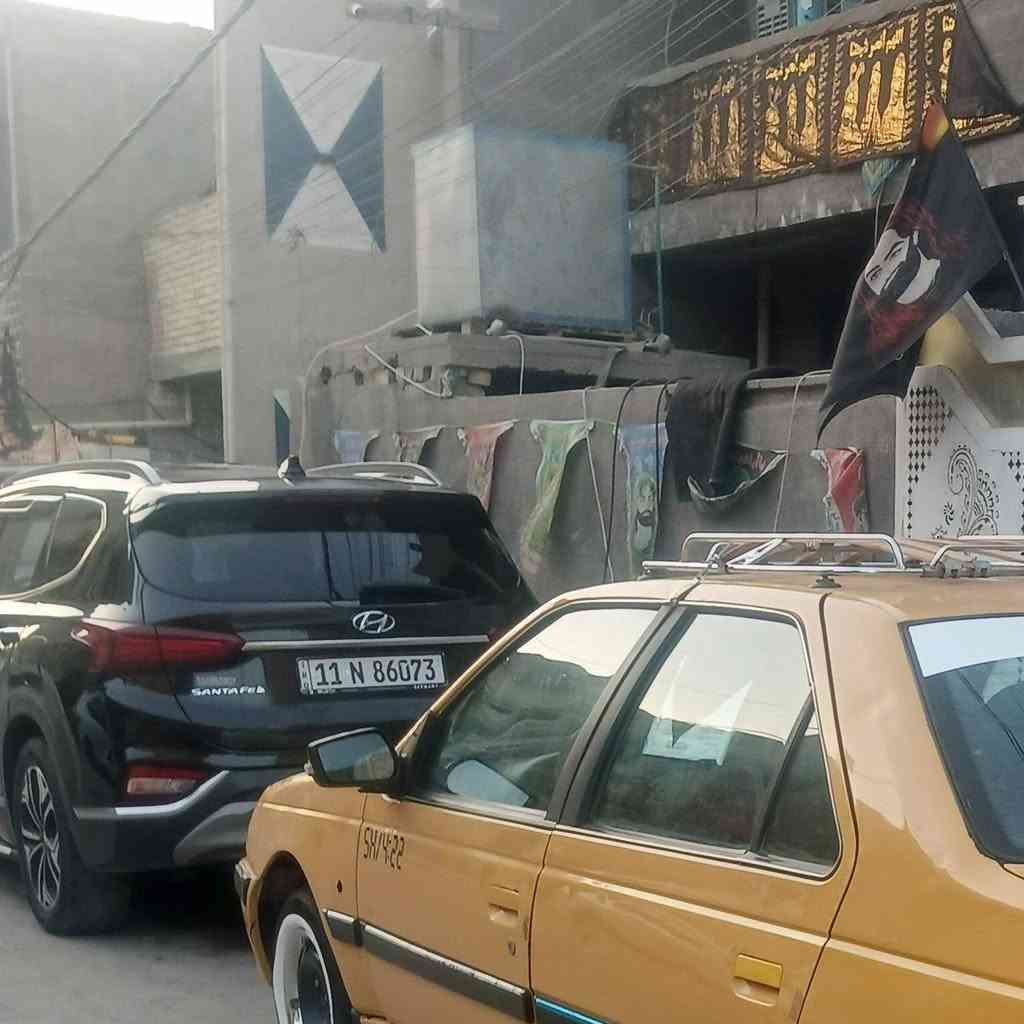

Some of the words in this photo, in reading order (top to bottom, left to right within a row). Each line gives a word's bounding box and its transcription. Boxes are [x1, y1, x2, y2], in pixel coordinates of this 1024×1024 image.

[315, 663, 343, 686] 11
[350, 661, 365, 684] N
[373, 658, 436, 683] 86073
[191, 687, 239, 696] SANTA
